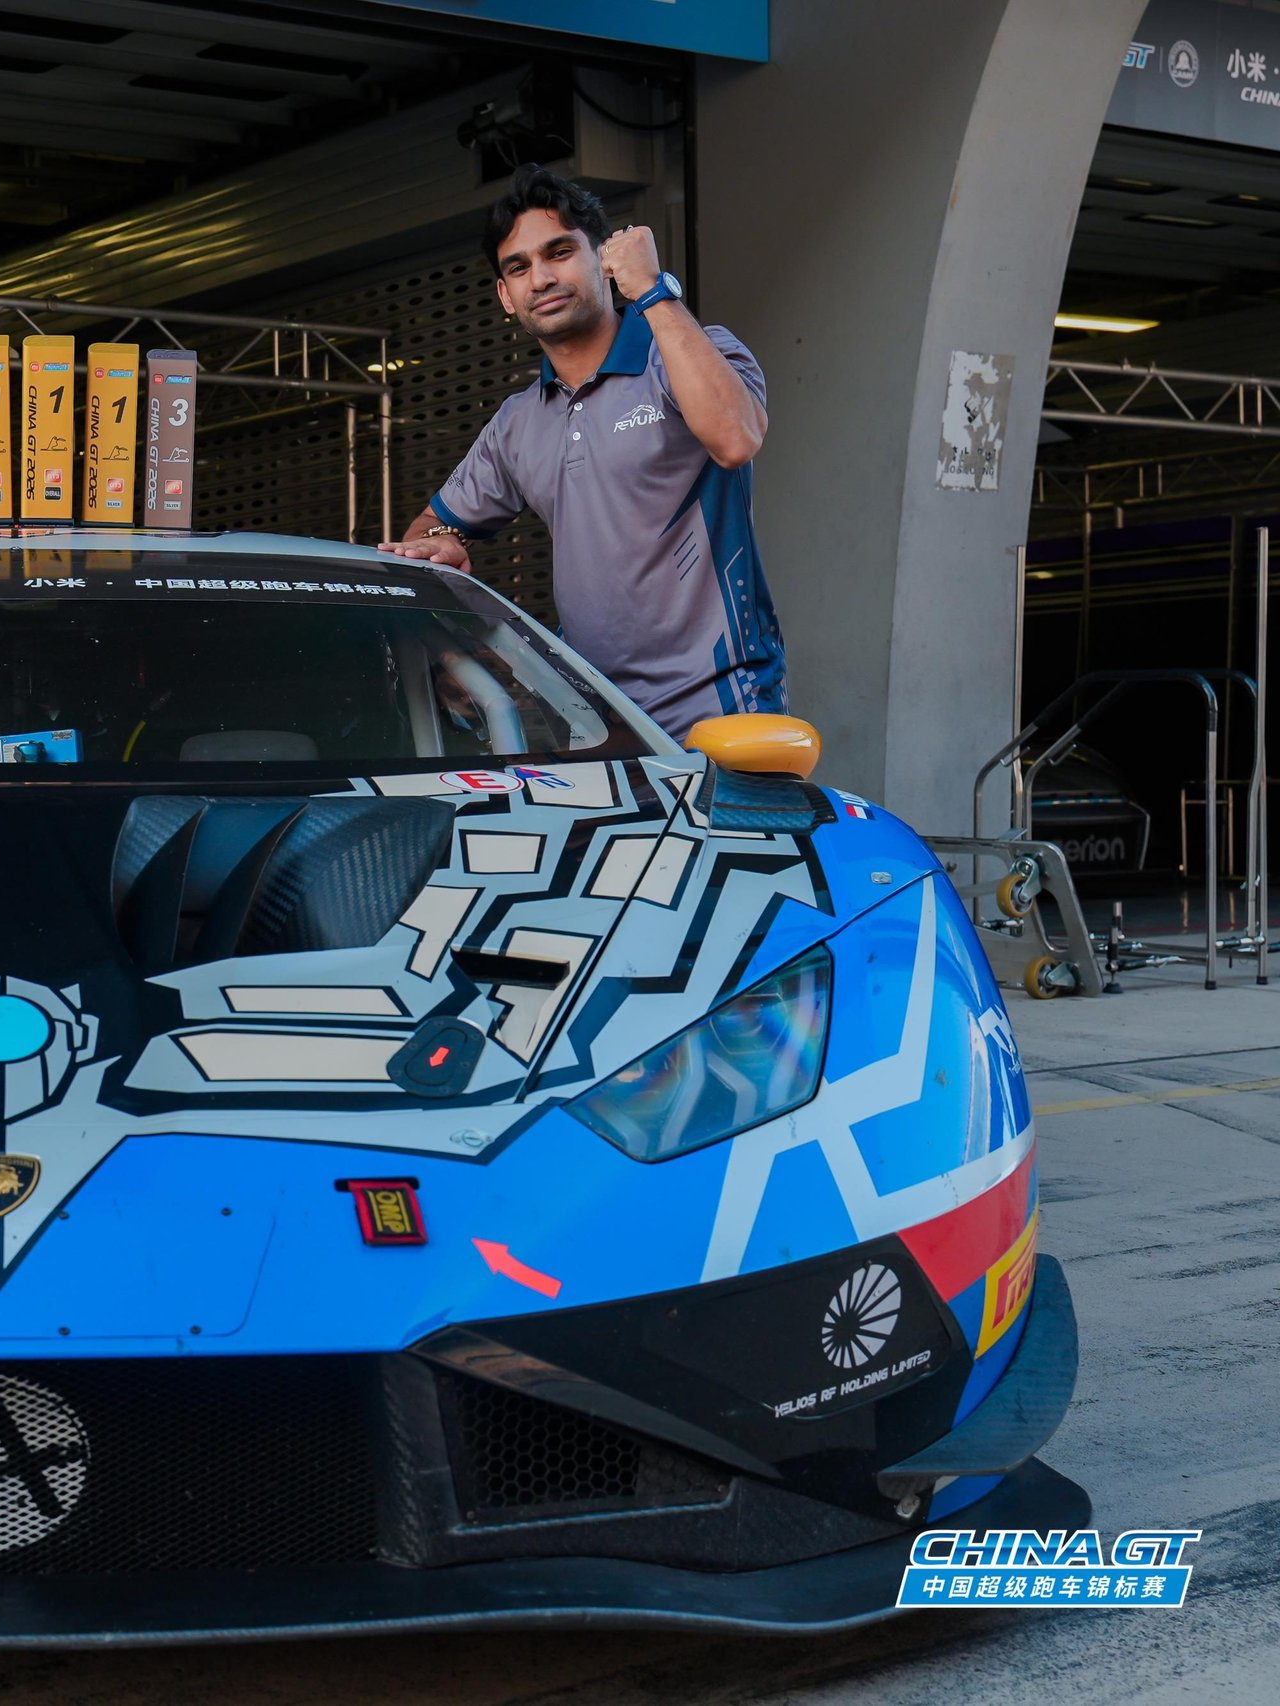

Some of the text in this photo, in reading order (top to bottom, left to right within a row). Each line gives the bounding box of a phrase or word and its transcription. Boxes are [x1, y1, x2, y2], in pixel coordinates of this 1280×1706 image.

[1226, 48, 1267, 82] 小米
[1240, 87, 1280, 107] CHIN
[49, 385, 65, 414] 1
[111, 396, 128, 424] 1
[168, 398, 190, 427] 3
[613, 410, 666, 432] REVURA
[26, 385, 38, 501] CHINA GT 2026
[88, 395, 100, 509] CHINA GT 2026
[147, 397, 160, 511] CHINA GT 2026
[23, 578, 417, 597] 小米 中国超级跑车锦标赛
[1062, 833, 1126, 861] erion
[375, 1190, 405, 1233] OMP
[774, 1350, 931, 1418] HELIOS RF HOLDING LIMITED
